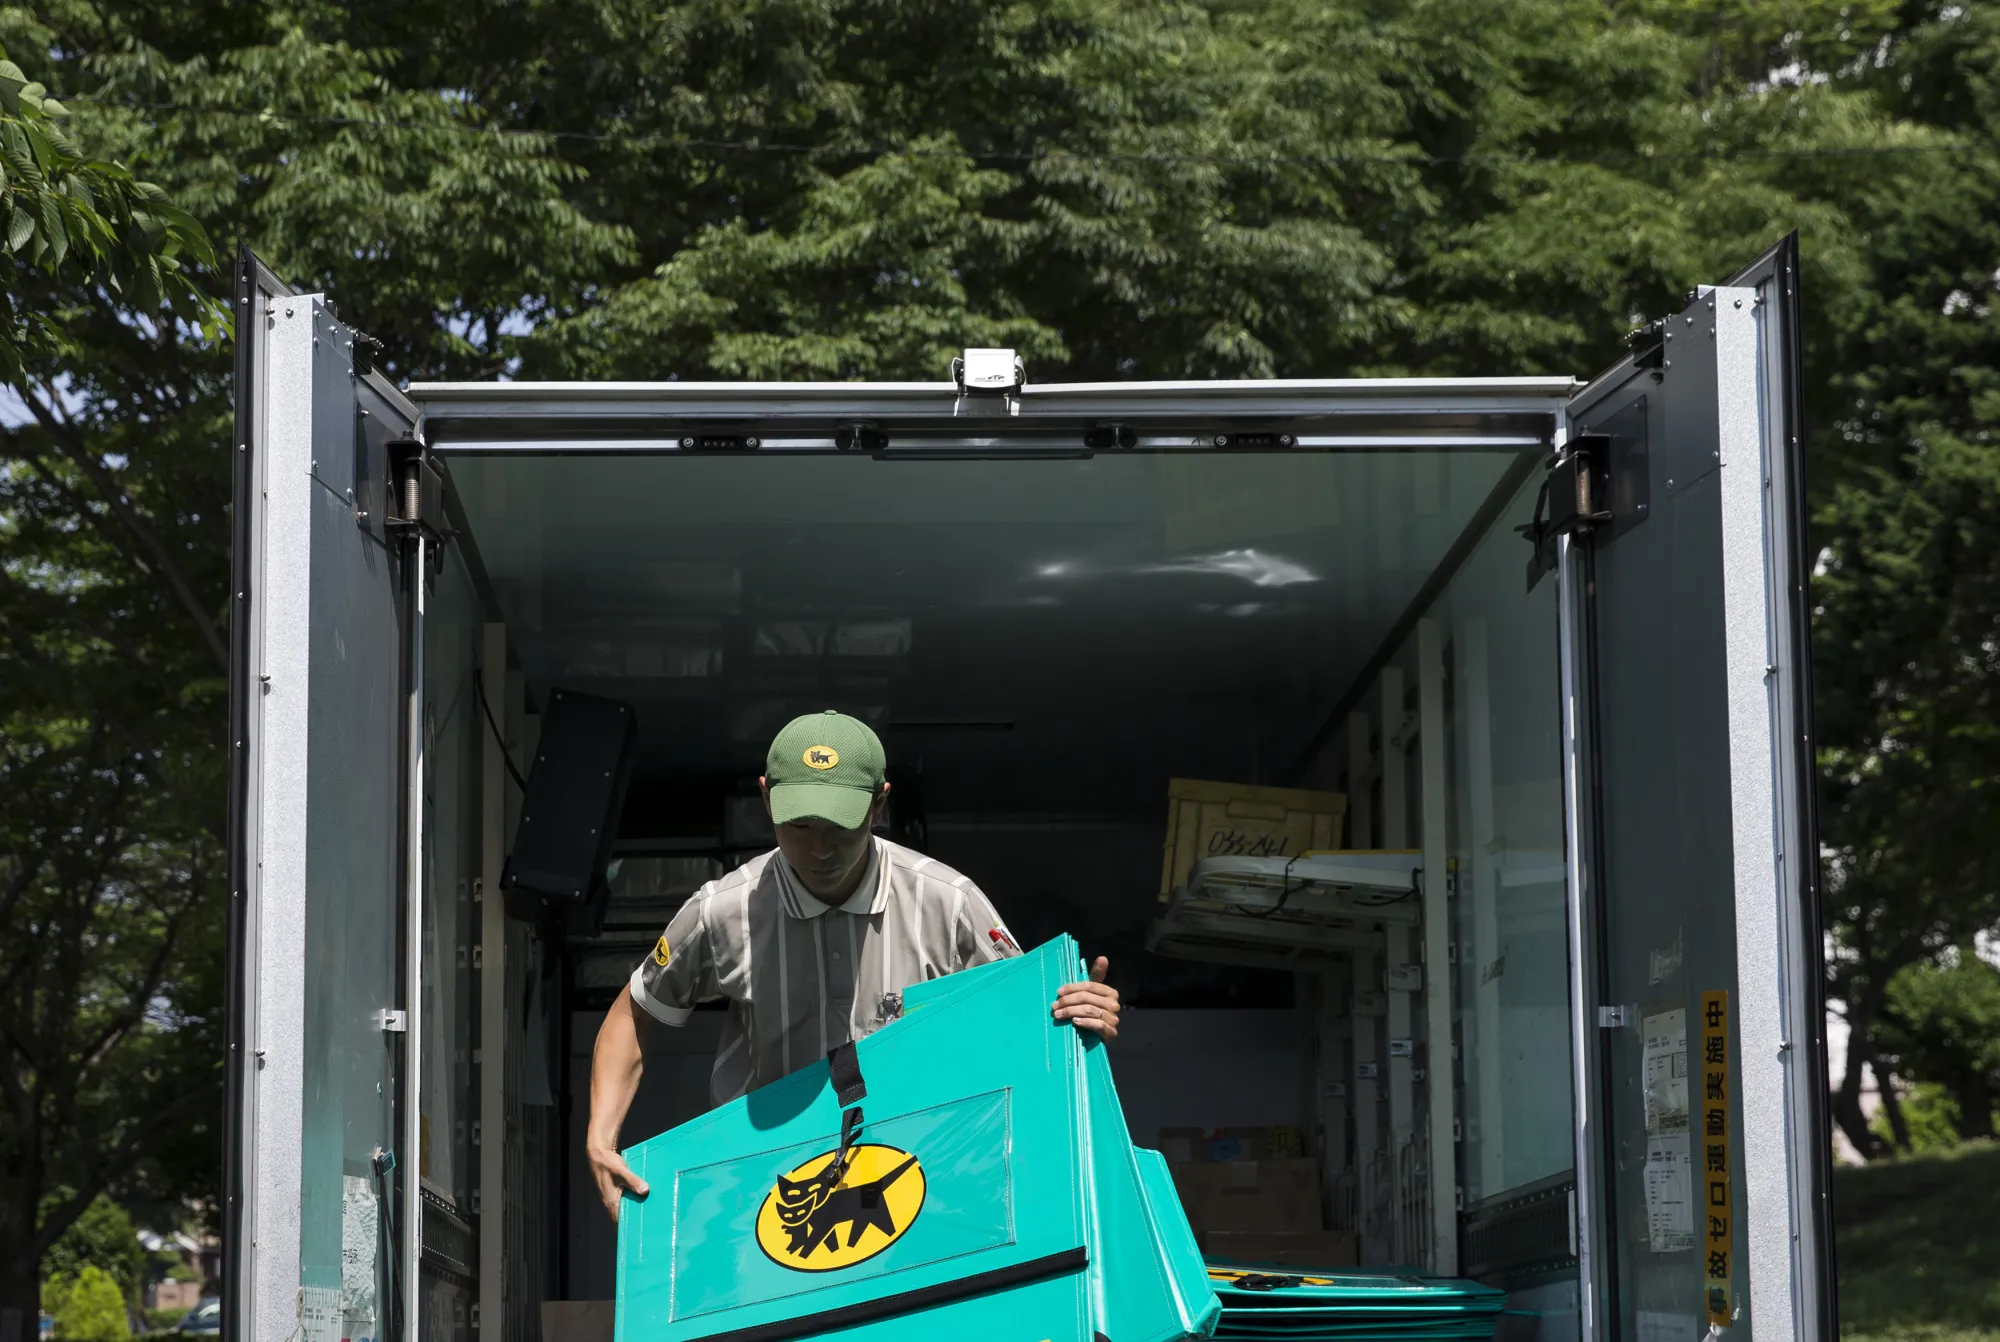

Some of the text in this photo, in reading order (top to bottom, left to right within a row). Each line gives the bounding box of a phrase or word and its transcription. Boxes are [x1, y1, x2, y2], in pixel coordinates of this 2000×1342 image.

[1706, 1001, 1727, 1315] 事故ゼロ運動実施中
